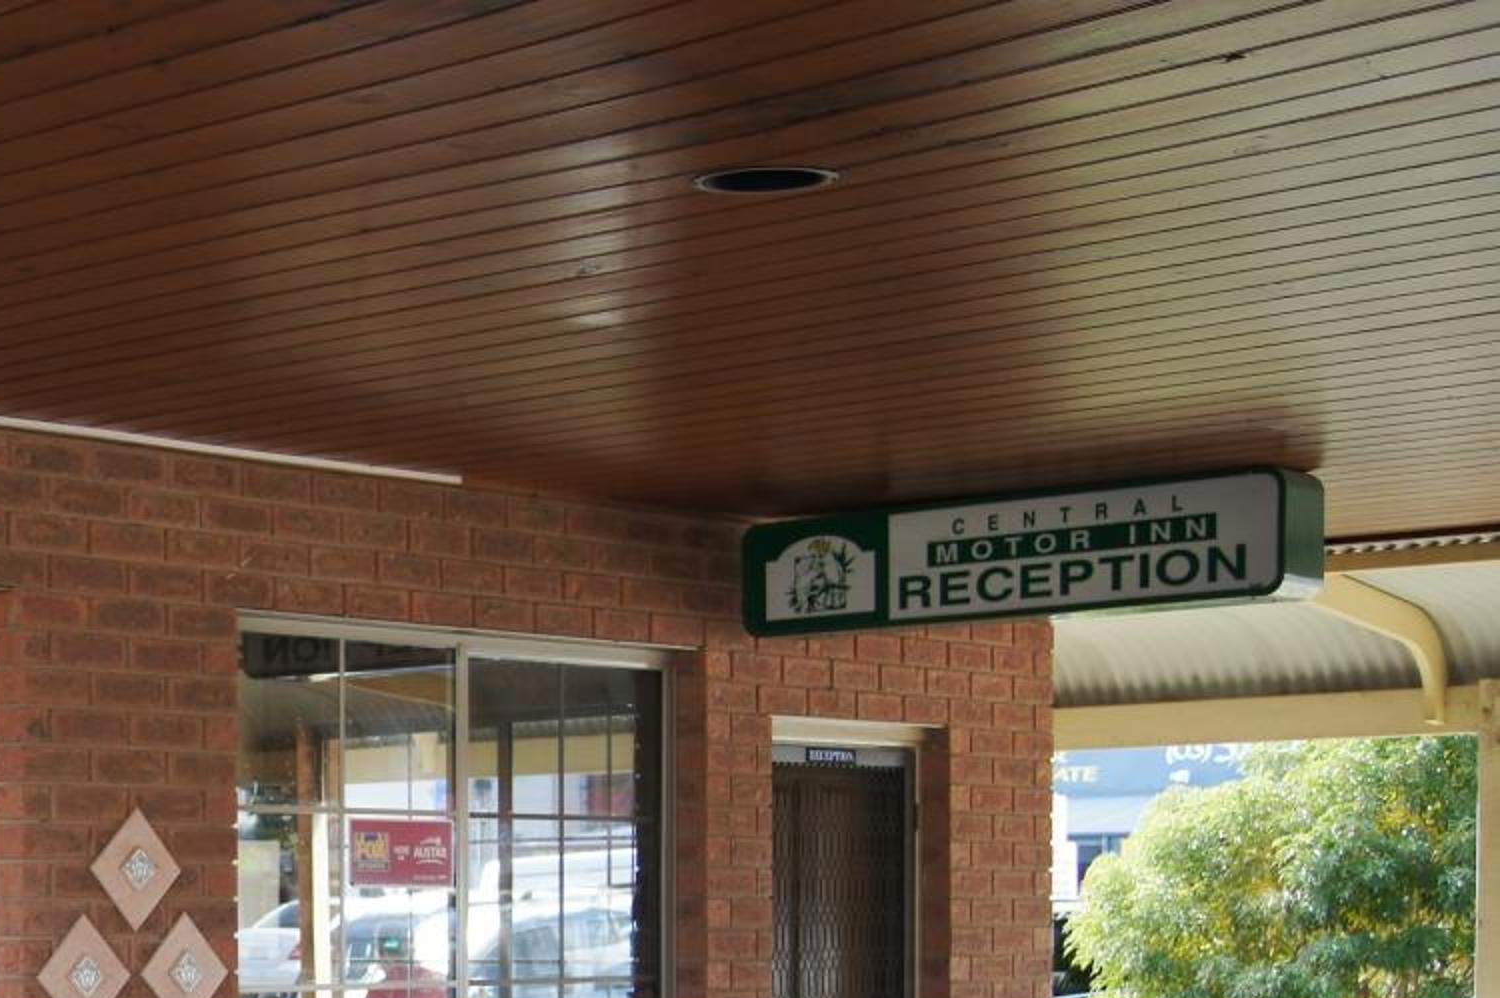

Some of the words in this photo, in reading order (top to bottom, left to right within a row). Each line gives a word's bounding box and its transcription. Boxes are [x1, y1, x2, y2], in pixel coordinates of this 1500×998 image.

[952, 495, 1184, 536] CENTRAL
[936, 530, 1092, 564] MOTOR
[1129, 516, 1208, 546] INN
[900, 543, 1248, 610] RECEPTION
